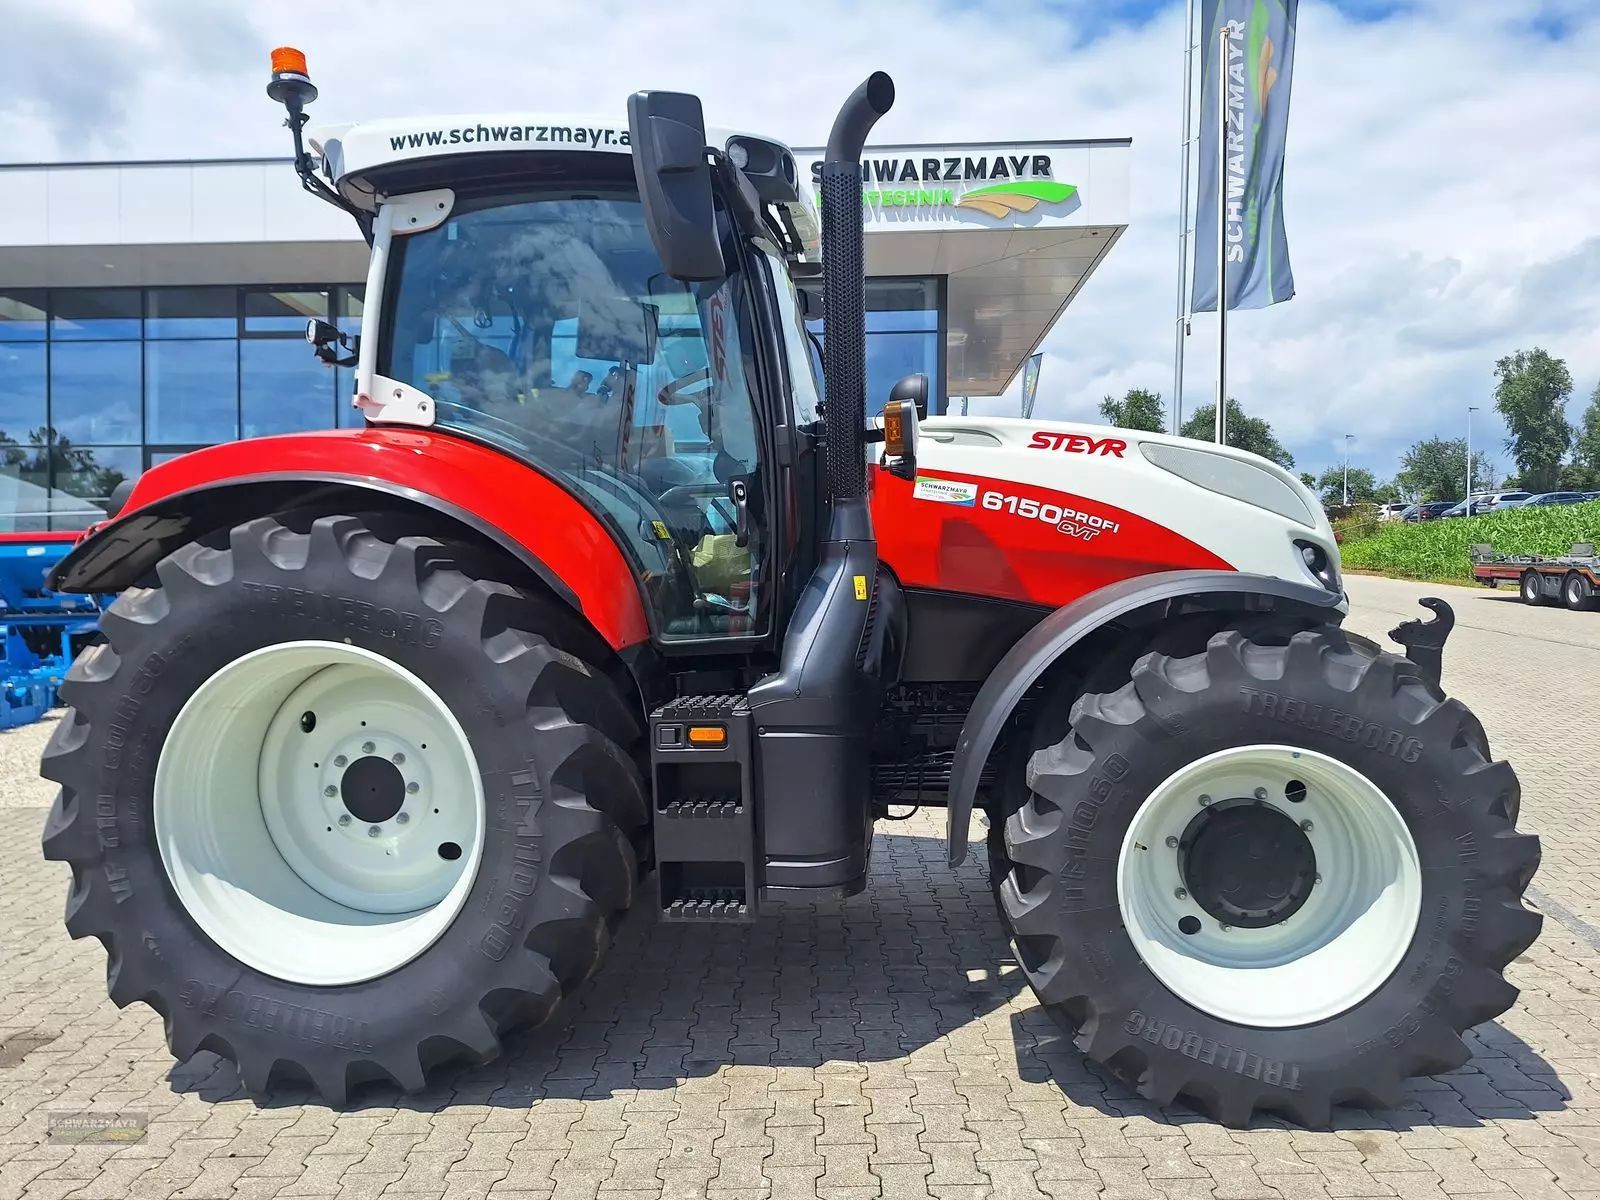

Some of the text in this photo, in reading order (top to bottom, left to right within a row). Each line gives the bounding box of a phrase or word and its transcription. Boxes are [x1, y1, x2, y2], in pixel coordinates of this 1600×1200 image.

[390, 123, 631, 151] www.schwarzmayr.a
[1227, 19, 1246, 263] SCHWARZMAYR
[811, 155, 1051, 184] SWARZMAYR
[1027, 431, 1127, 459] STEYR
[920, 482, 968, 494] SCHWARZMAYR
[982, 491, 1120, 533] 6150 PROFI
[1056, 519, 1101, 541] CVT
[1239, 685, 1425, 763] TRELLEBORG
[480, 753, 544, 962] TM1060
[1120, 1009, 1304, 1092] TRELLEBORG
